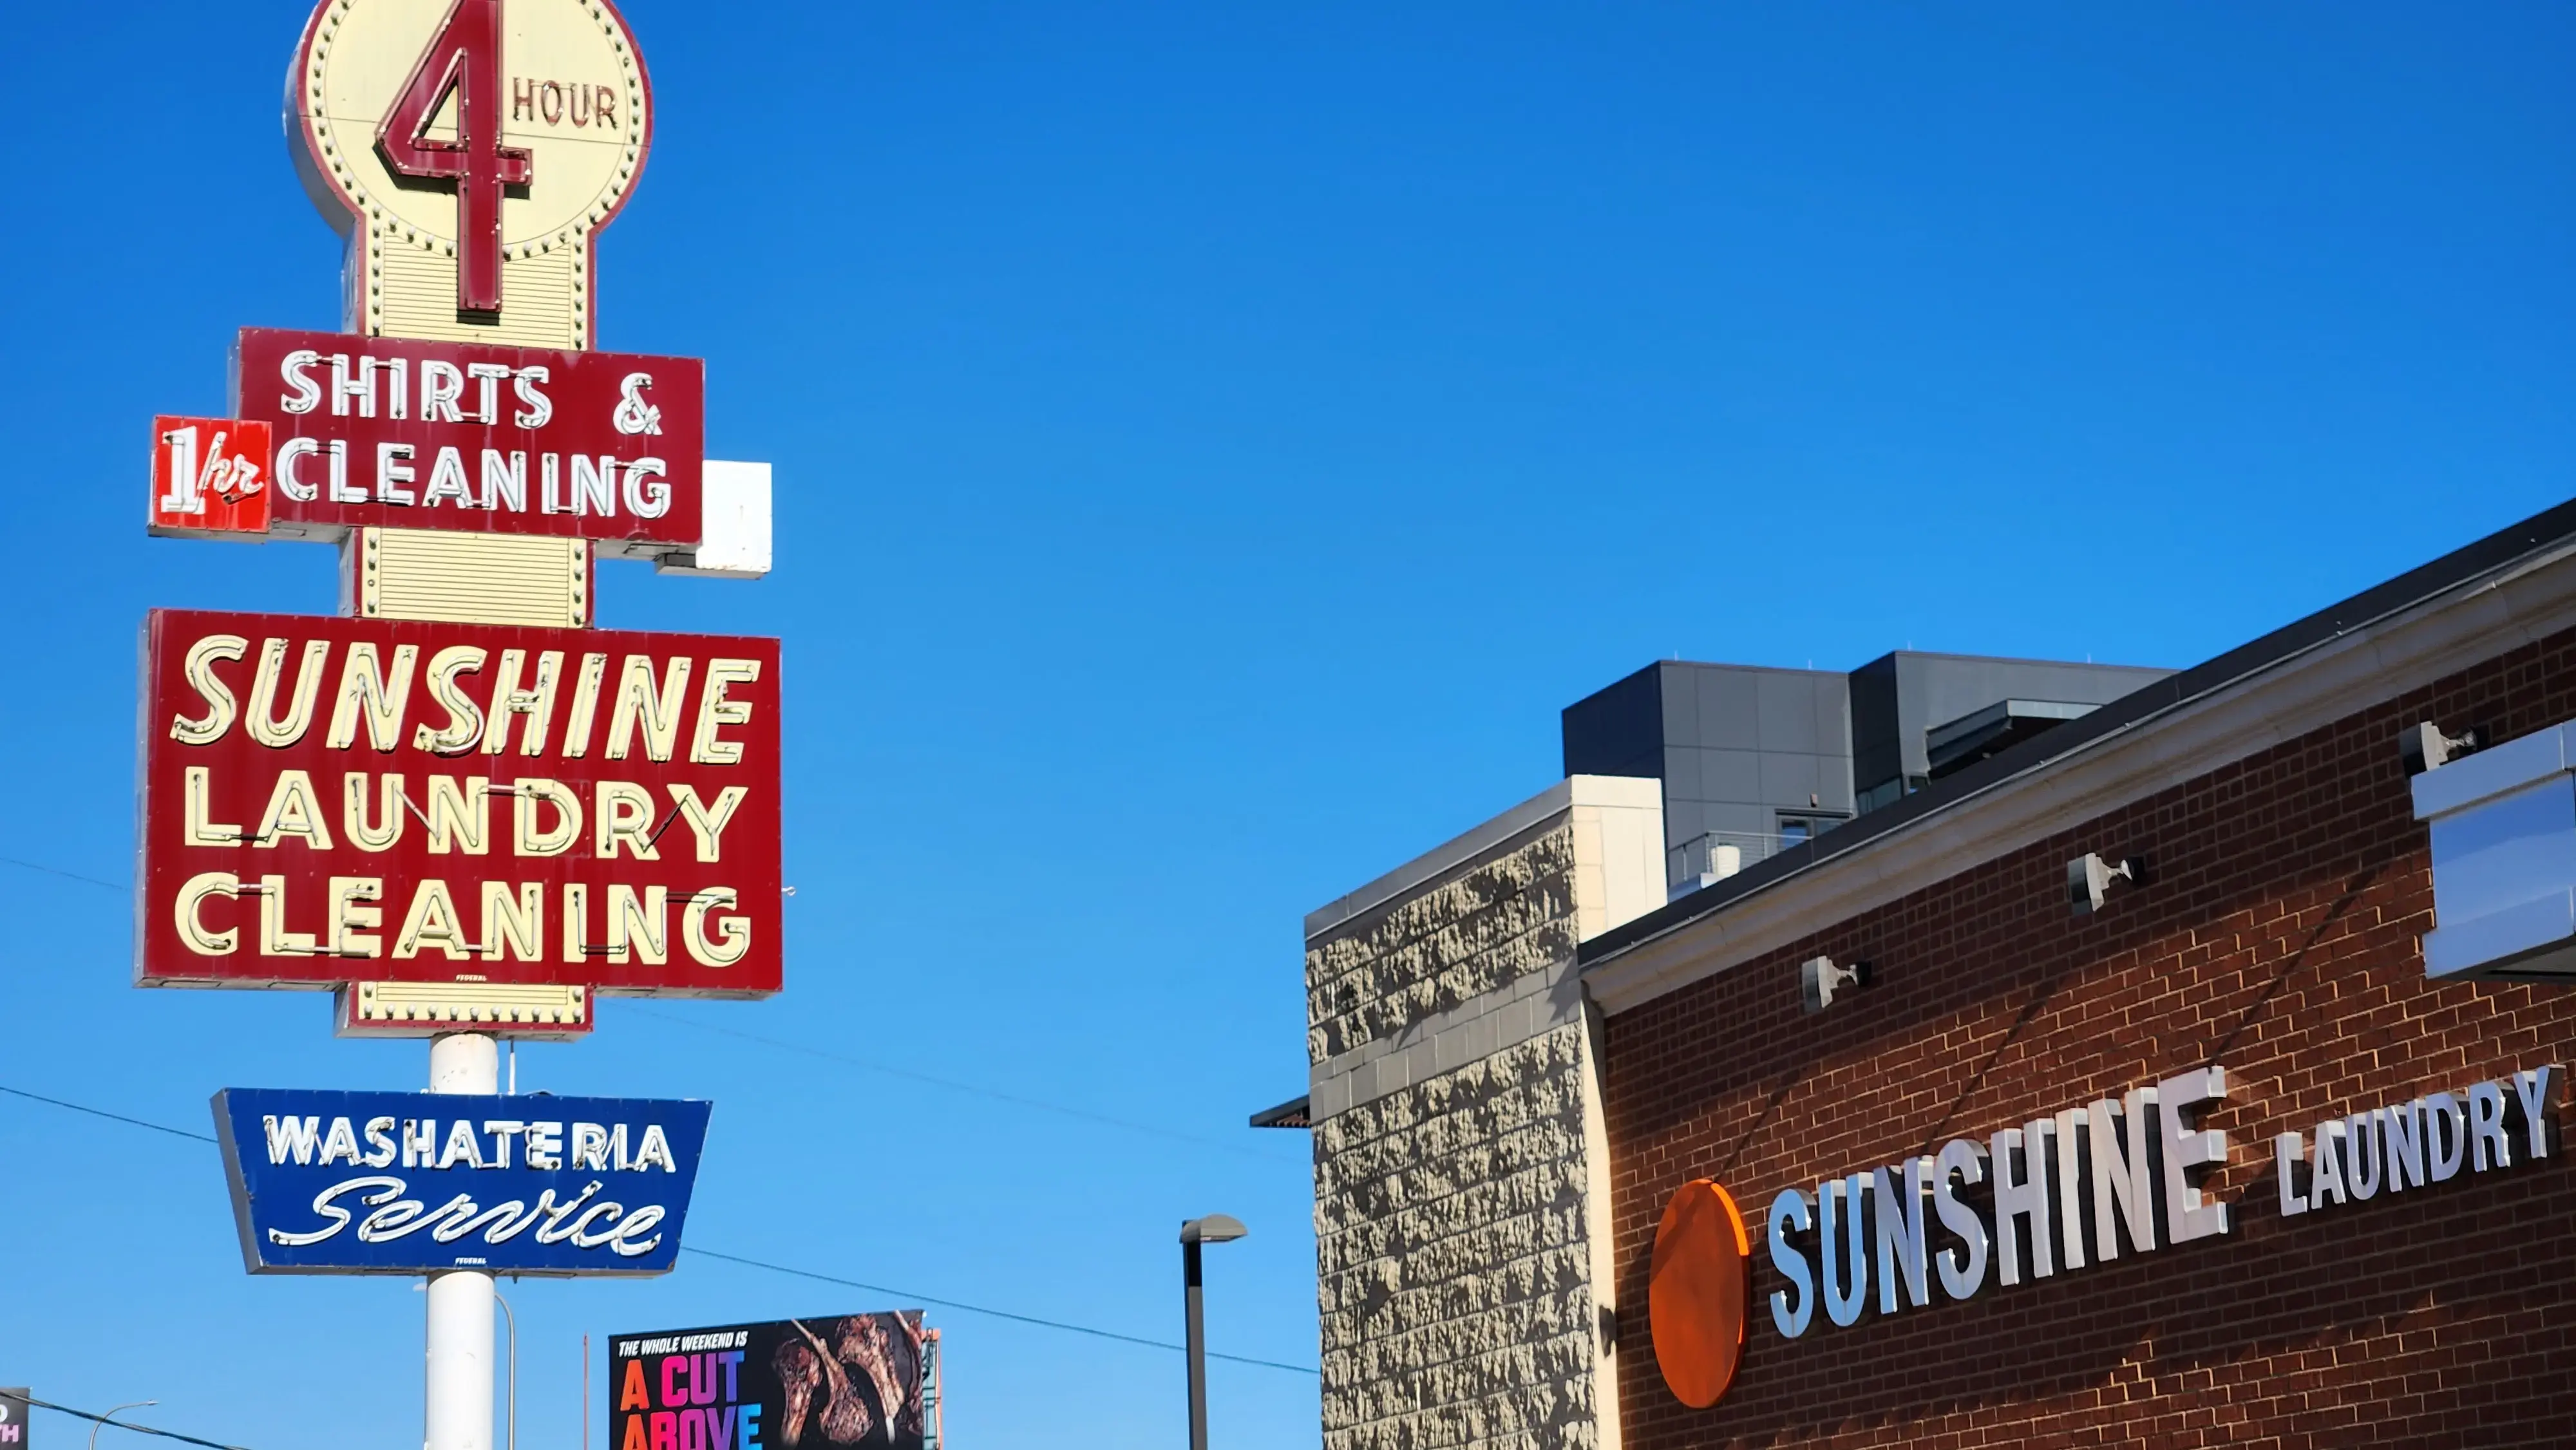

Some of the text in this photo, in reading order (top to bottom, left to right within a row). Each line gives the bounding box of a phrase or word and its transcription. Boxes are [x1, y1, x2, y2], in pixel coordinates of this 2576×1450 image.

[374, 0, 620, 312] 4 HOUR
[280, 350, 663, 435] SHIRTS &
[275, 437, 671, 519] CLEANING
[169, 634, 761, 765] SUNSHINE
[184, 766, 749, 863] LAUNDRY
[174, 871, 752, 968] CLEANING
[262, 1114, 677, 1173] WASHATERIA
[269, 1176, 665, 1256] Service
[1768, 1064, 2566, 1338] SUNSHINE LAUNDRY
[618, 1330, 749, 1358] THE WHOLE WEEKEND IS
[620, 1350, 745, 1411] A CUT
[622, 1403, 762, 1450] ABOVE
